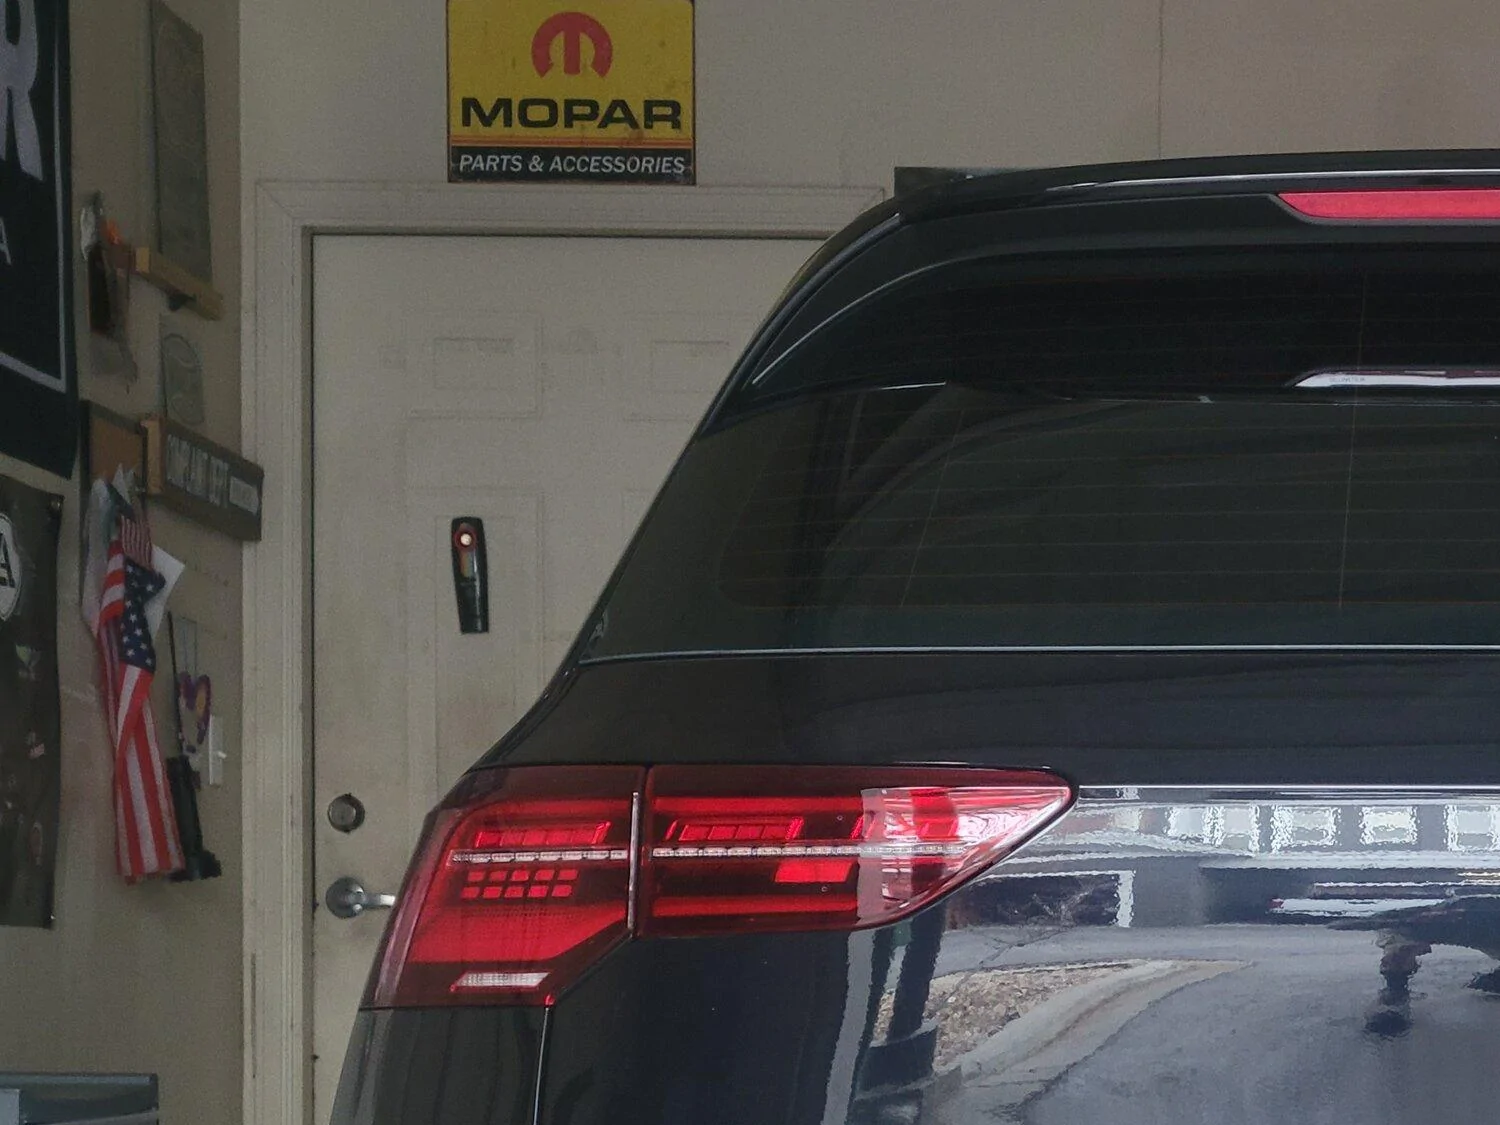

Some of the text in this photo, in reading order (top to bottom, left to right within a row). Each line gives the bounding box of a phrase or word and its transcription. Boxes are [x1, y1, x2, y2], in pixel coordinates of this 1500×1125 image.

[461, 97, 682, 130] MOPAR
[459, 154, 685, 175] PARTS & ACCESSORIES
